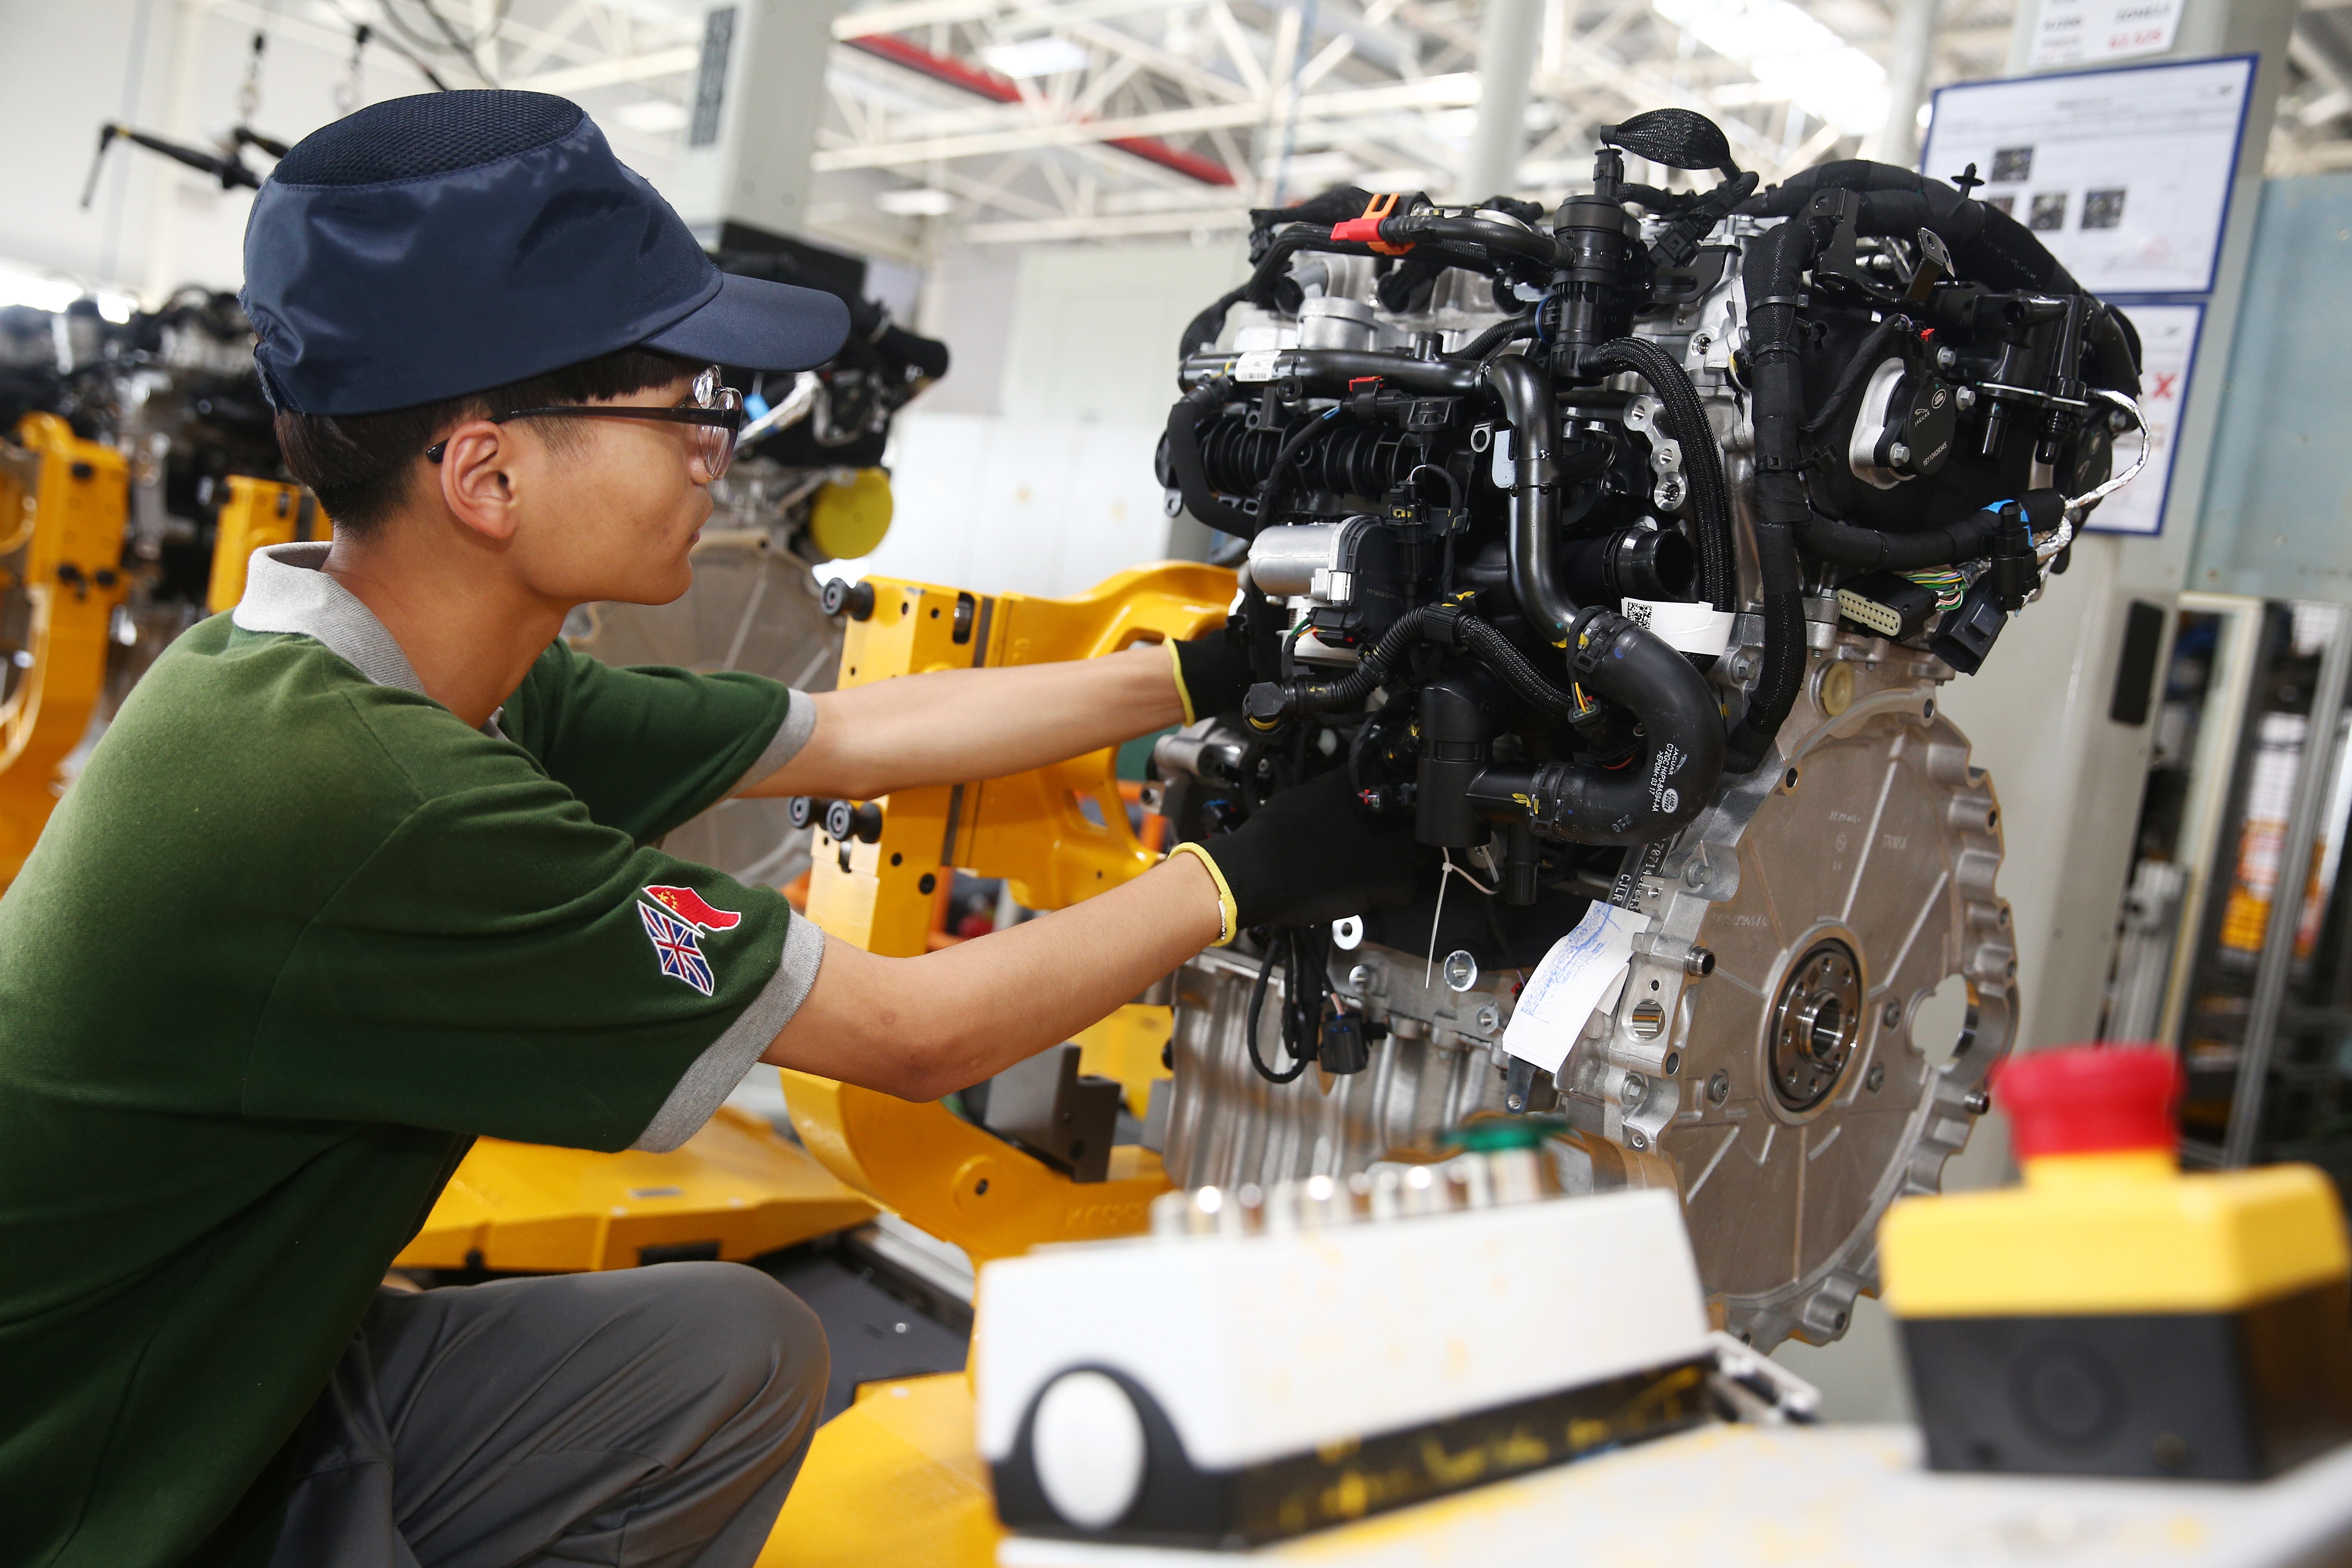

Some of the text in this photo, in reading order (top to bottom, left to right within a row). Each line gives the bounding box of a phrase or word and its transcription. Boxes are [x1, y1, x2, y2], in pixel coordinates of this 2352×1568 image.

[1915, 411, 1930, 427] JAGUAR
[1923, 441, 1947, 466] 16110409345
[1648, 751, 1663, 795] >EPDM< 03 17
[1668, 747, 1679, 775] JAGUAR
[1652, 743, 1674, 811] C72GC H4P3-8A594-AA
[1613, 874, 1630, 902] CJLR
[1570, 950, 1593, 973] CJLR
